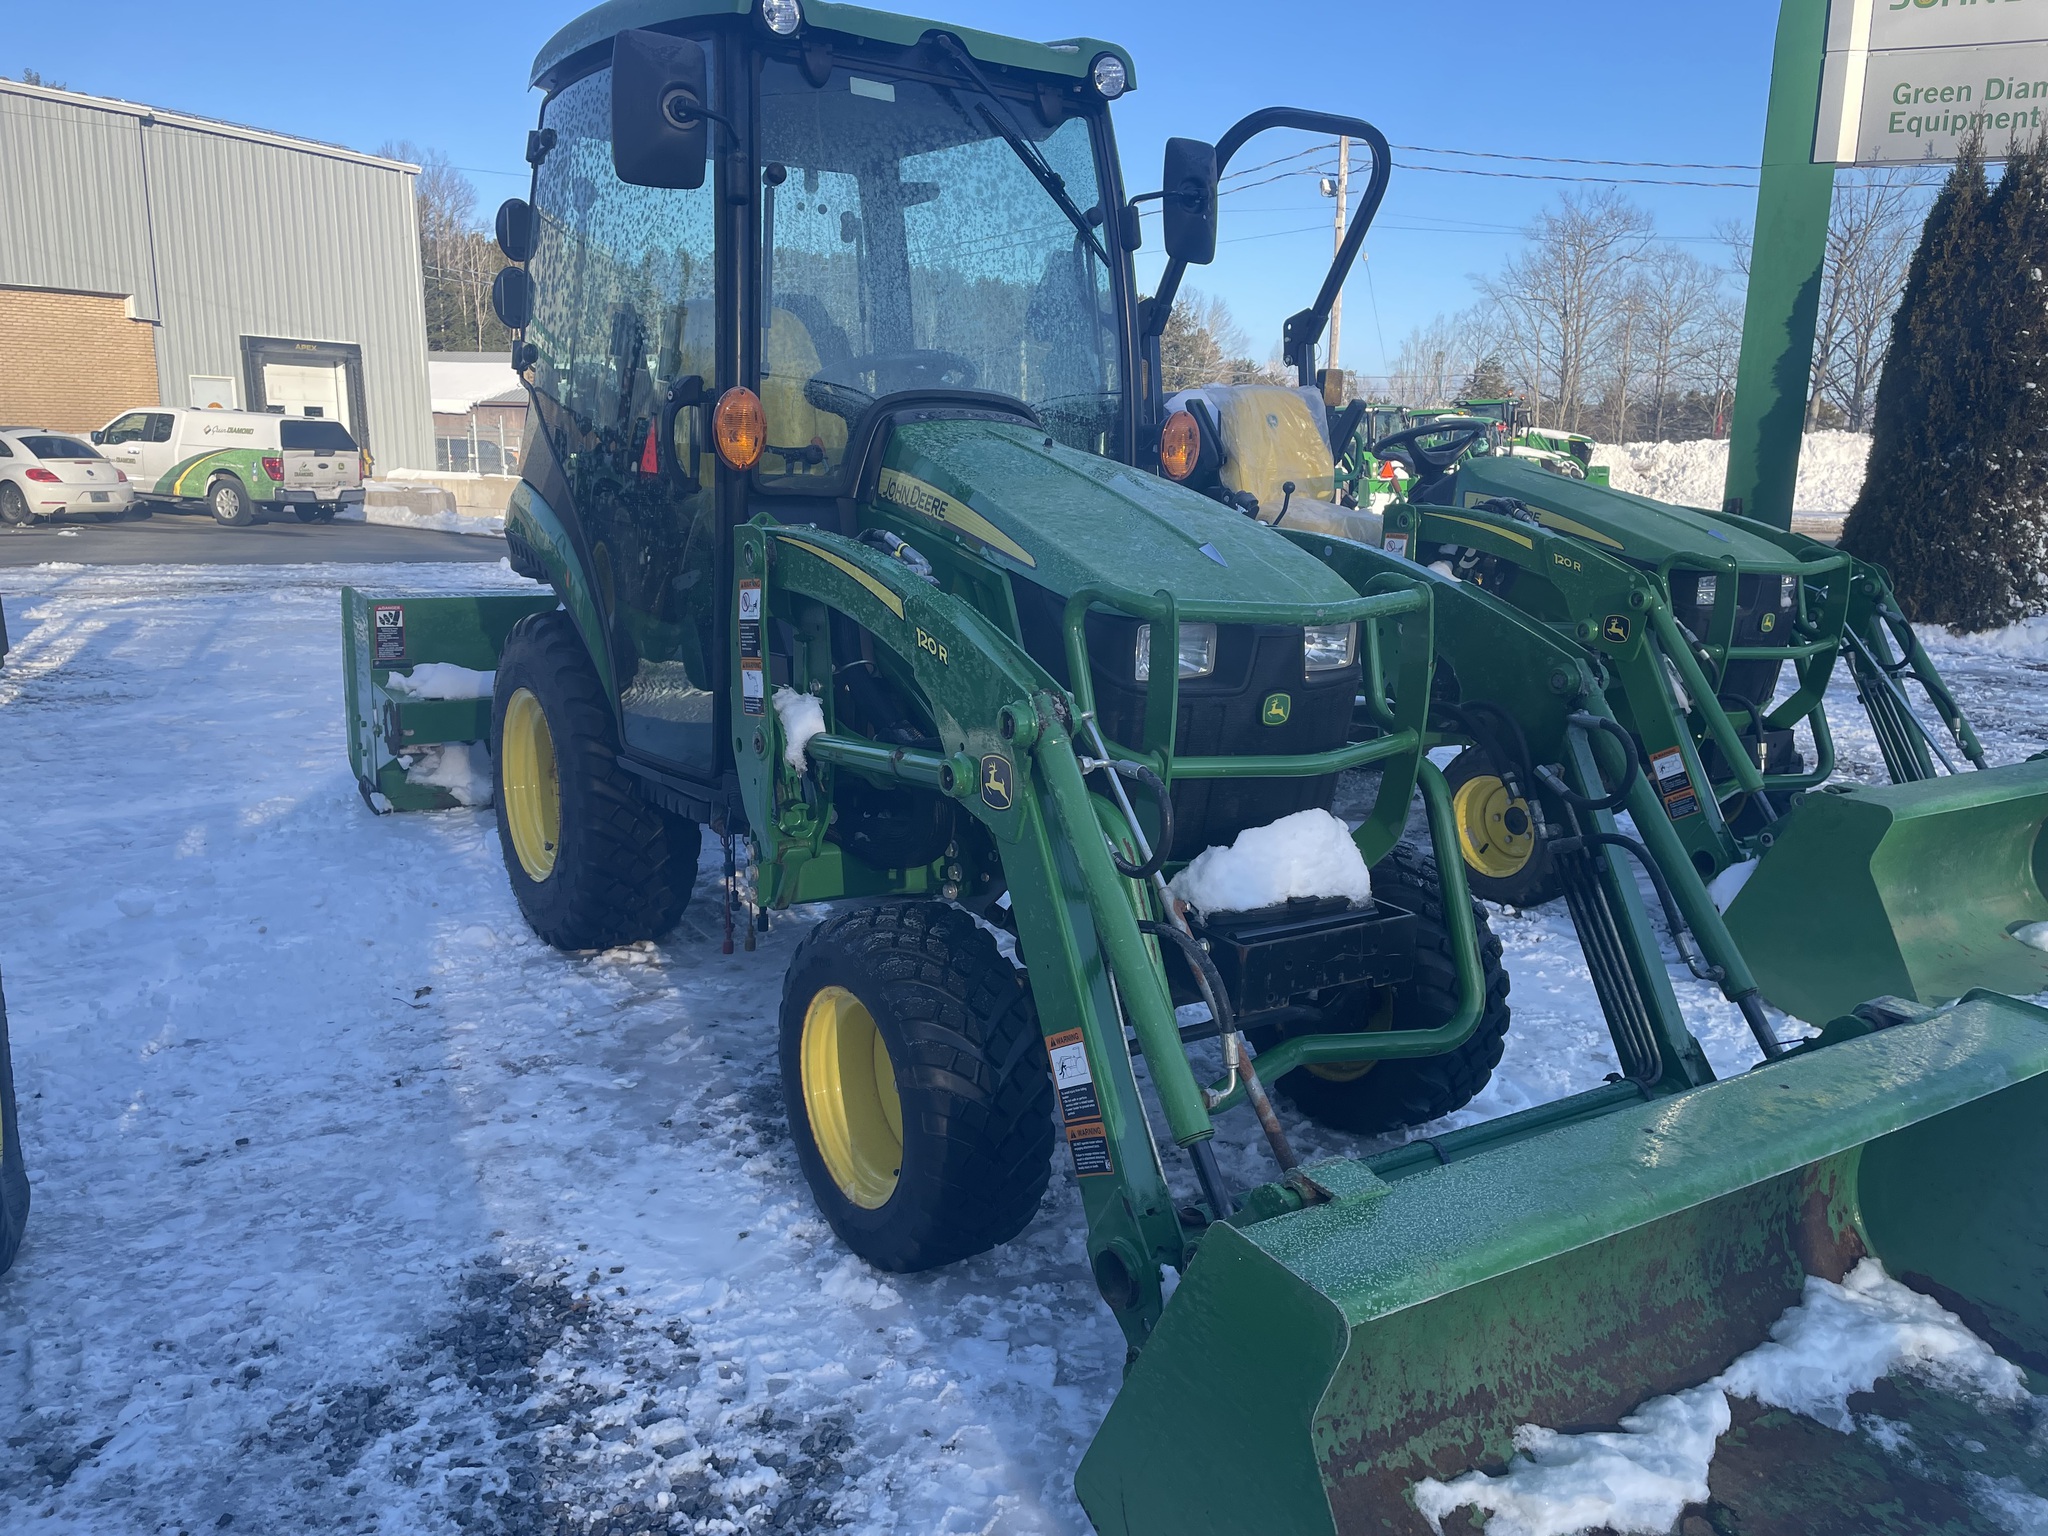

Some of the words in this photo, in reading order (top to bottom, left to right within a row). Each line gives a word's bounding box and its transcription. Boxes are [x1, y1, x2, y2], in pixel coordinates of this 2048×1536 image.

[1893, 82, 1971, 105] Green
[1888, 106, 2040, 137] Equipment
[295, 343, 317, 351] APEX
[884, 477, 910, 505] JOHN
[911, 485, 948, 519] DEERE
[1553, 553, 1572, 568] 120
[1573, 561, 1581, 572] R
[916, 627, 937, 655] 120
[939, 644, 949, 665] R
[1055, 1033, 1080, 1045] WARNING
[1077, 1127, 1101, 1136] WARNING
